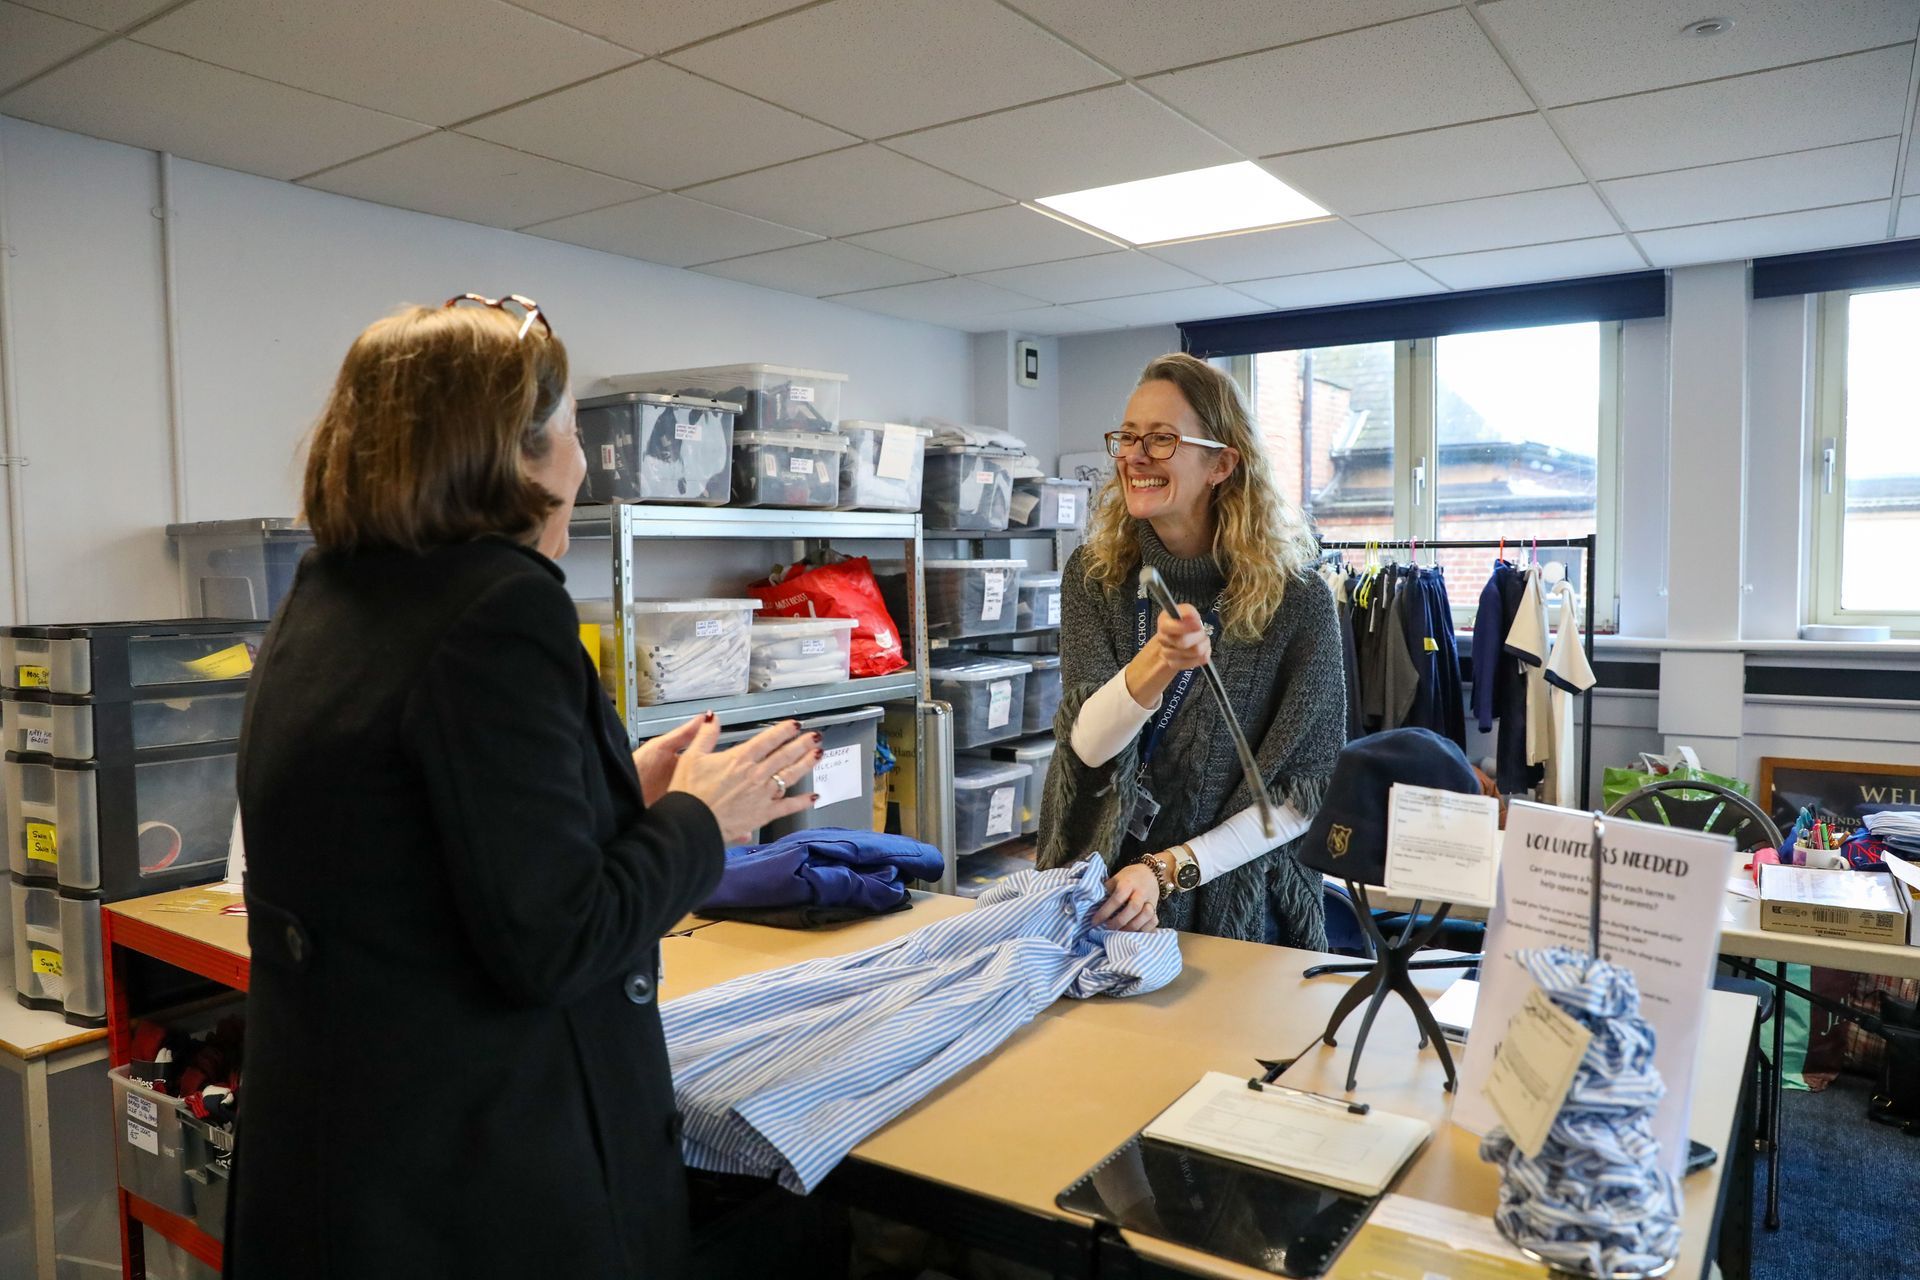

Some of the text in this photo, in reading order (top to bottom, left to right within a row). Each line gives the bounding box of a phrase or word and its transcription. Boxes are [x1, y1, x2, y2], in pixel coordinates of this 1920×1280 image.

[1138, 608, 1147, 647] SCHOOL
[1156, 694, 1181, 729] SCHOOL
[1819, 814, 1862, 827] RIENDS
[1526, 832, 1689, 878] VOLUNTERS NEEDED
[1529, 864, 1543, 872] Can
[1544, 868, 1557, 876] you
[1559, 872, 1578, 881] spare
[1600, 880, 1623, 891] hours
[1625, 885, 1643, 893] each
[1645, 889, 1664, 898] term
[1666, 893, 1676, 901] to
[1540, 879, 1556, 890] help
[1557, 884, 1576, 893] open
[1577, 887, 1589, 896] the
[1610, 894, 1621, 903] for
